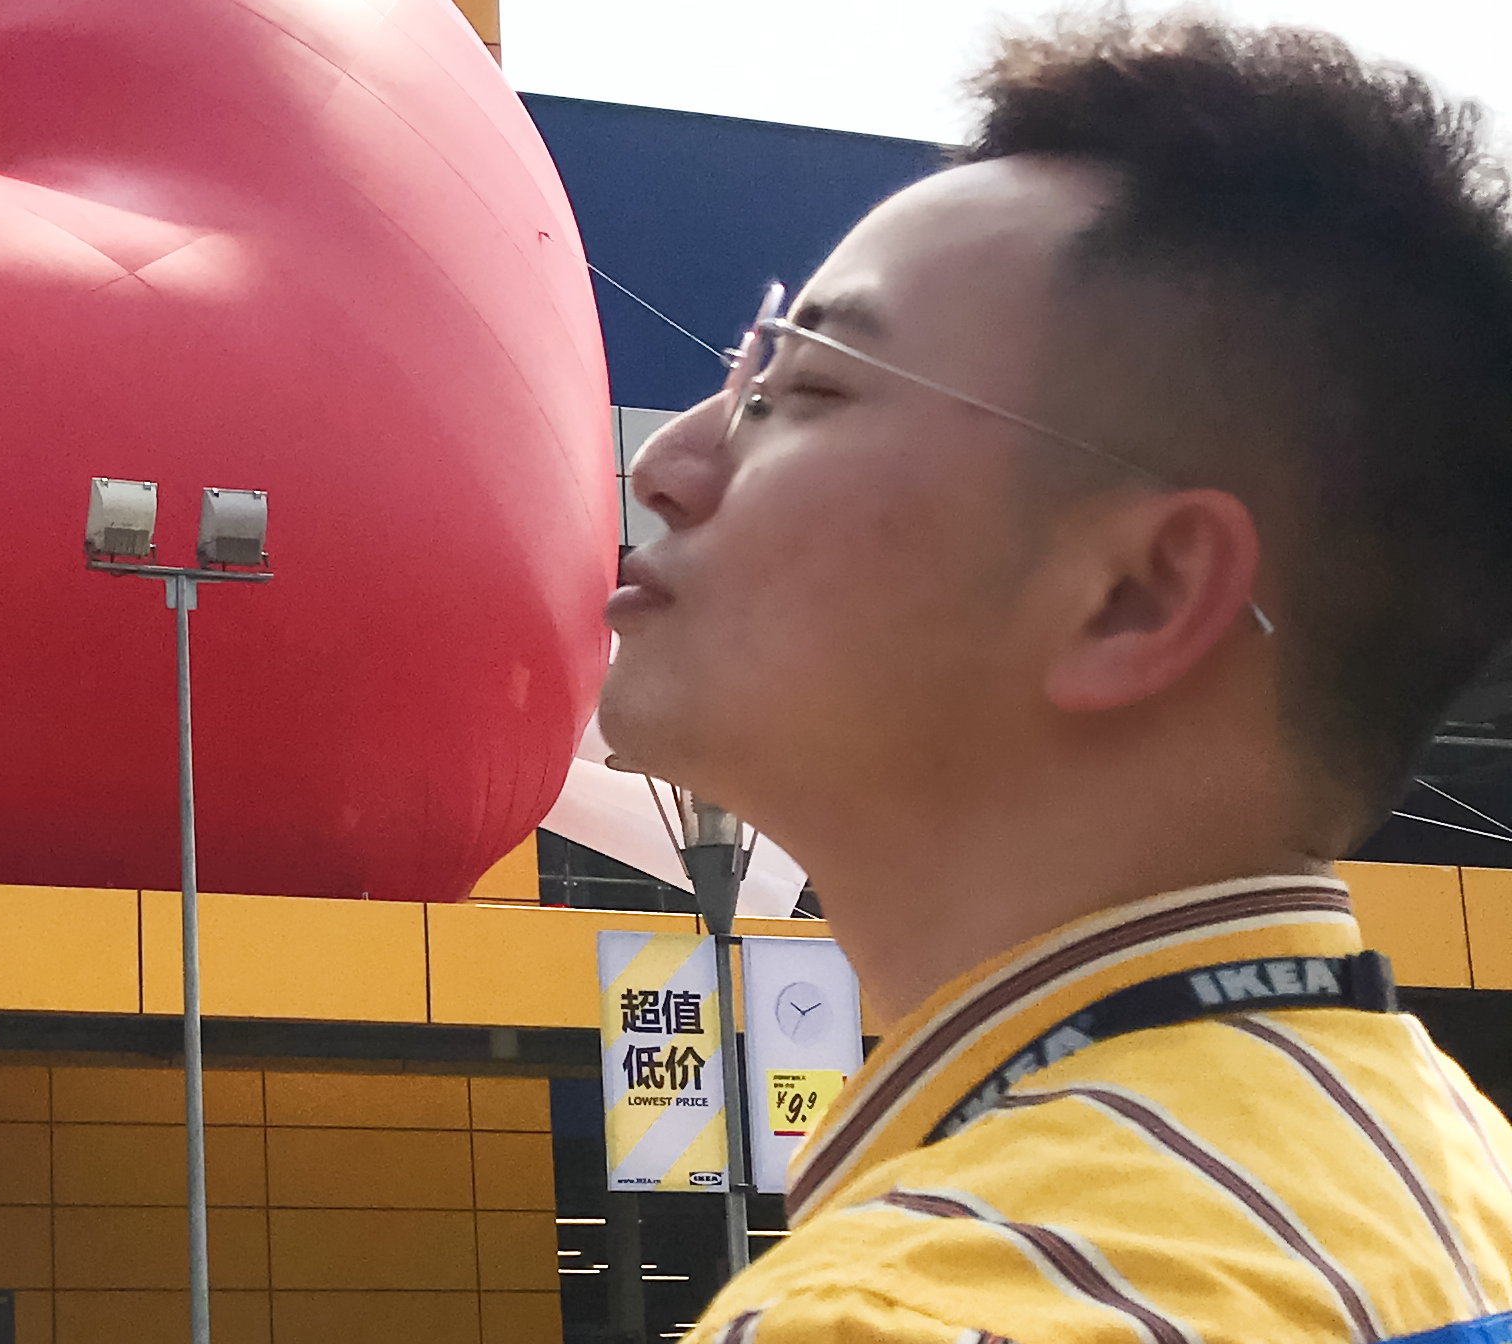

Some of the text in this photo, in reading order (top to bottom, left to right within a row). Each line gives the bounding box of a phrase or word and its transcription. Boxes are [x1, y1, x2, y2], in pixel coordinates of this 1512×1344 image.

[1190, 959, 1343, 1005] IKEA
[620, 988, 705, 1035] 超值
[622, 1044, 706, 1090] 低价
[627, 1096, 709, 1107] LOWEST PRICE
